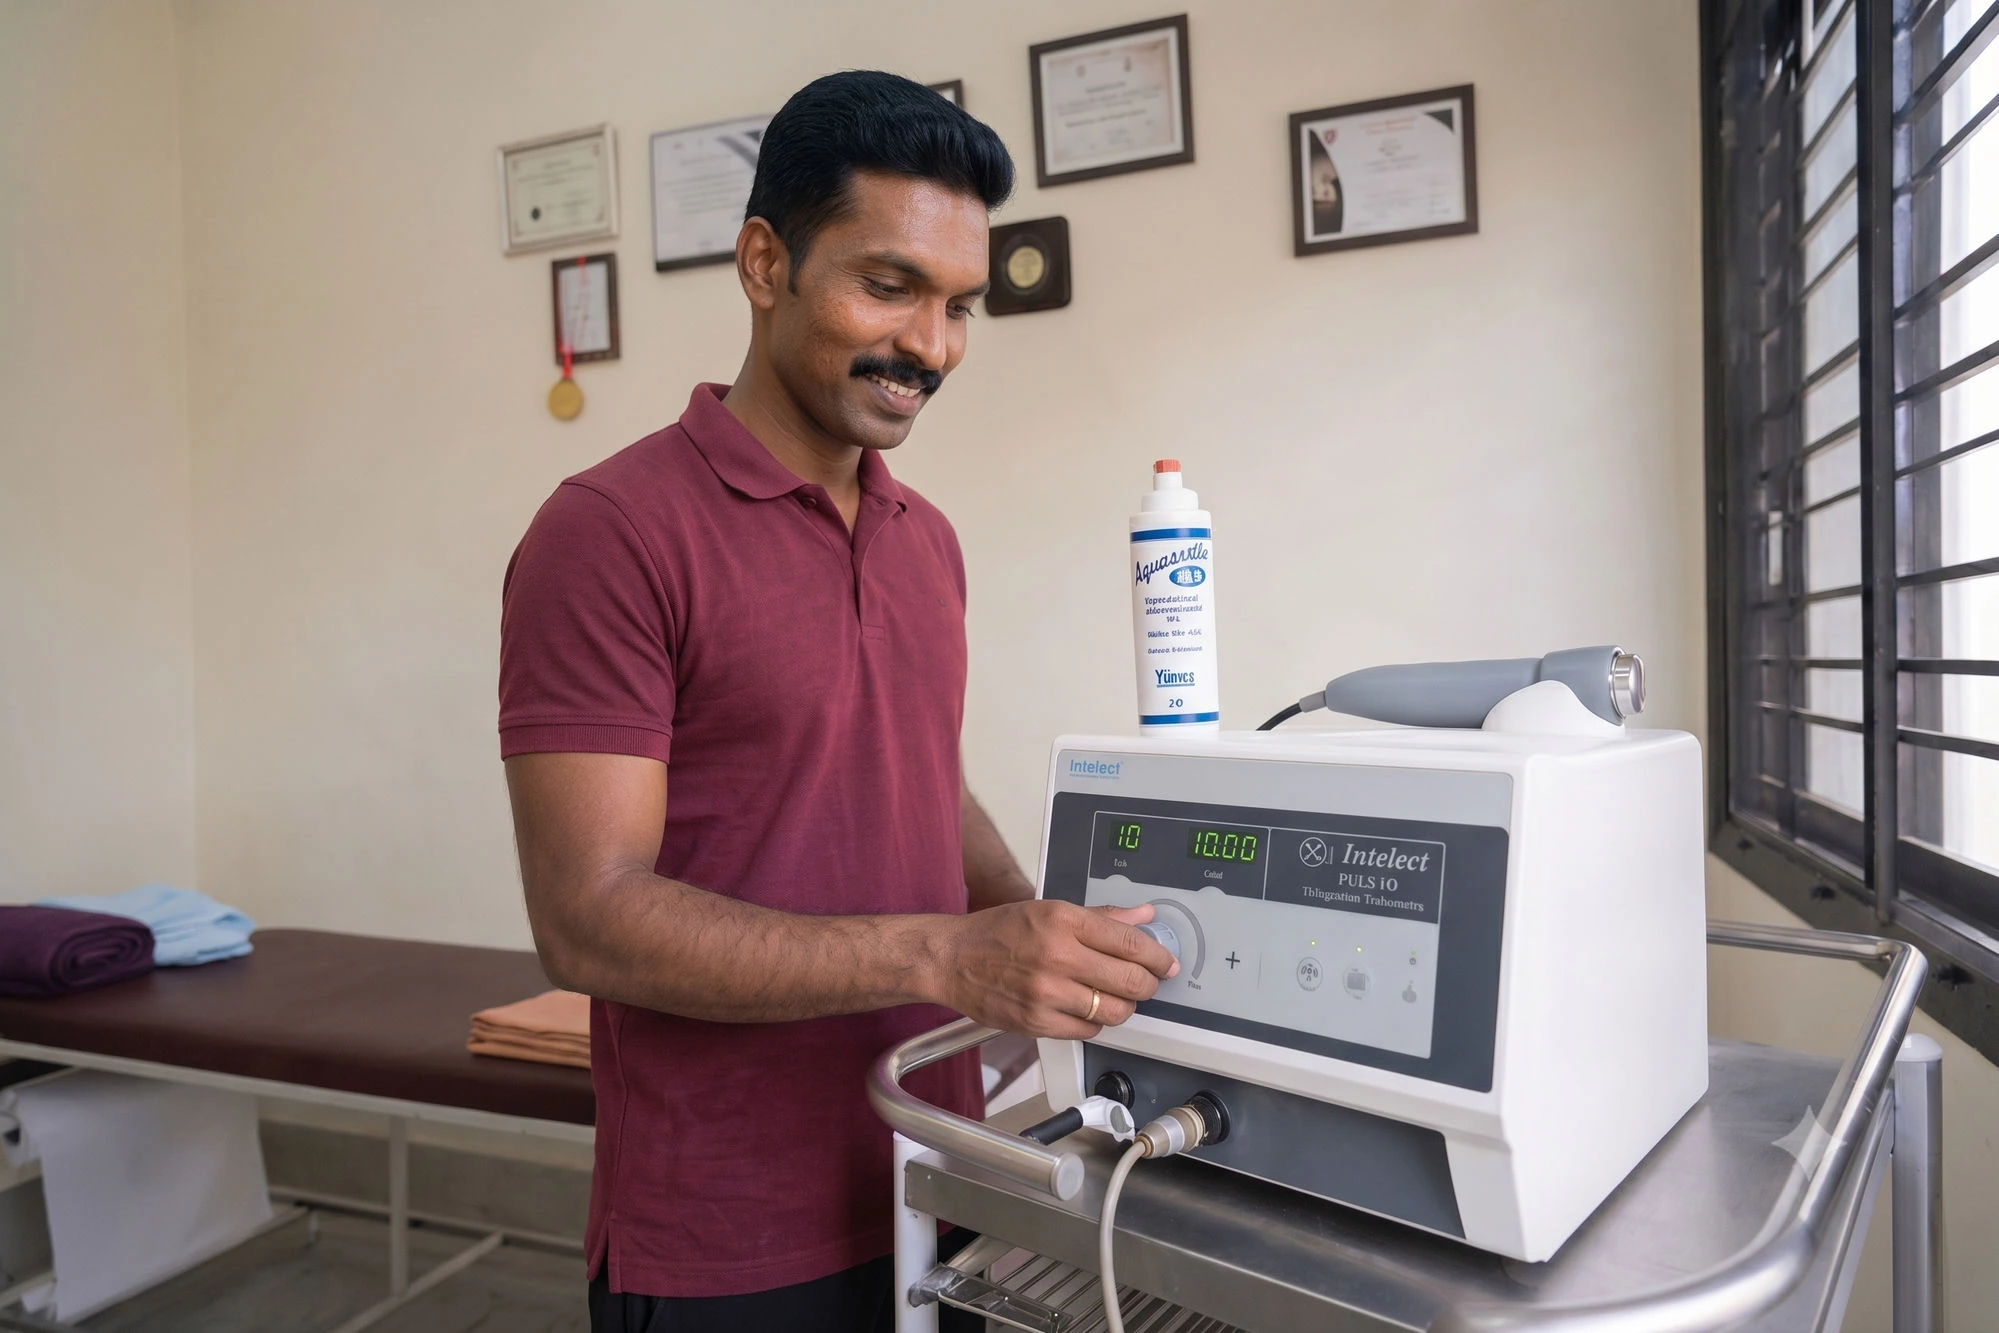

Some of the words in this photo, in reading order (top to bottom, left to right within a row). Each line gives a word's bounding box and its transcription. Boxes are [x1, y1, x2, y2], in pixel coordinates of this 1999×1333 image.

[1070, 759, 1121, 775] Intelect
[1117, 824, 1142, 849] 10
[1341, 842, 1431, 872] Intelect
[1338, 872, 1376, 890] PULS
